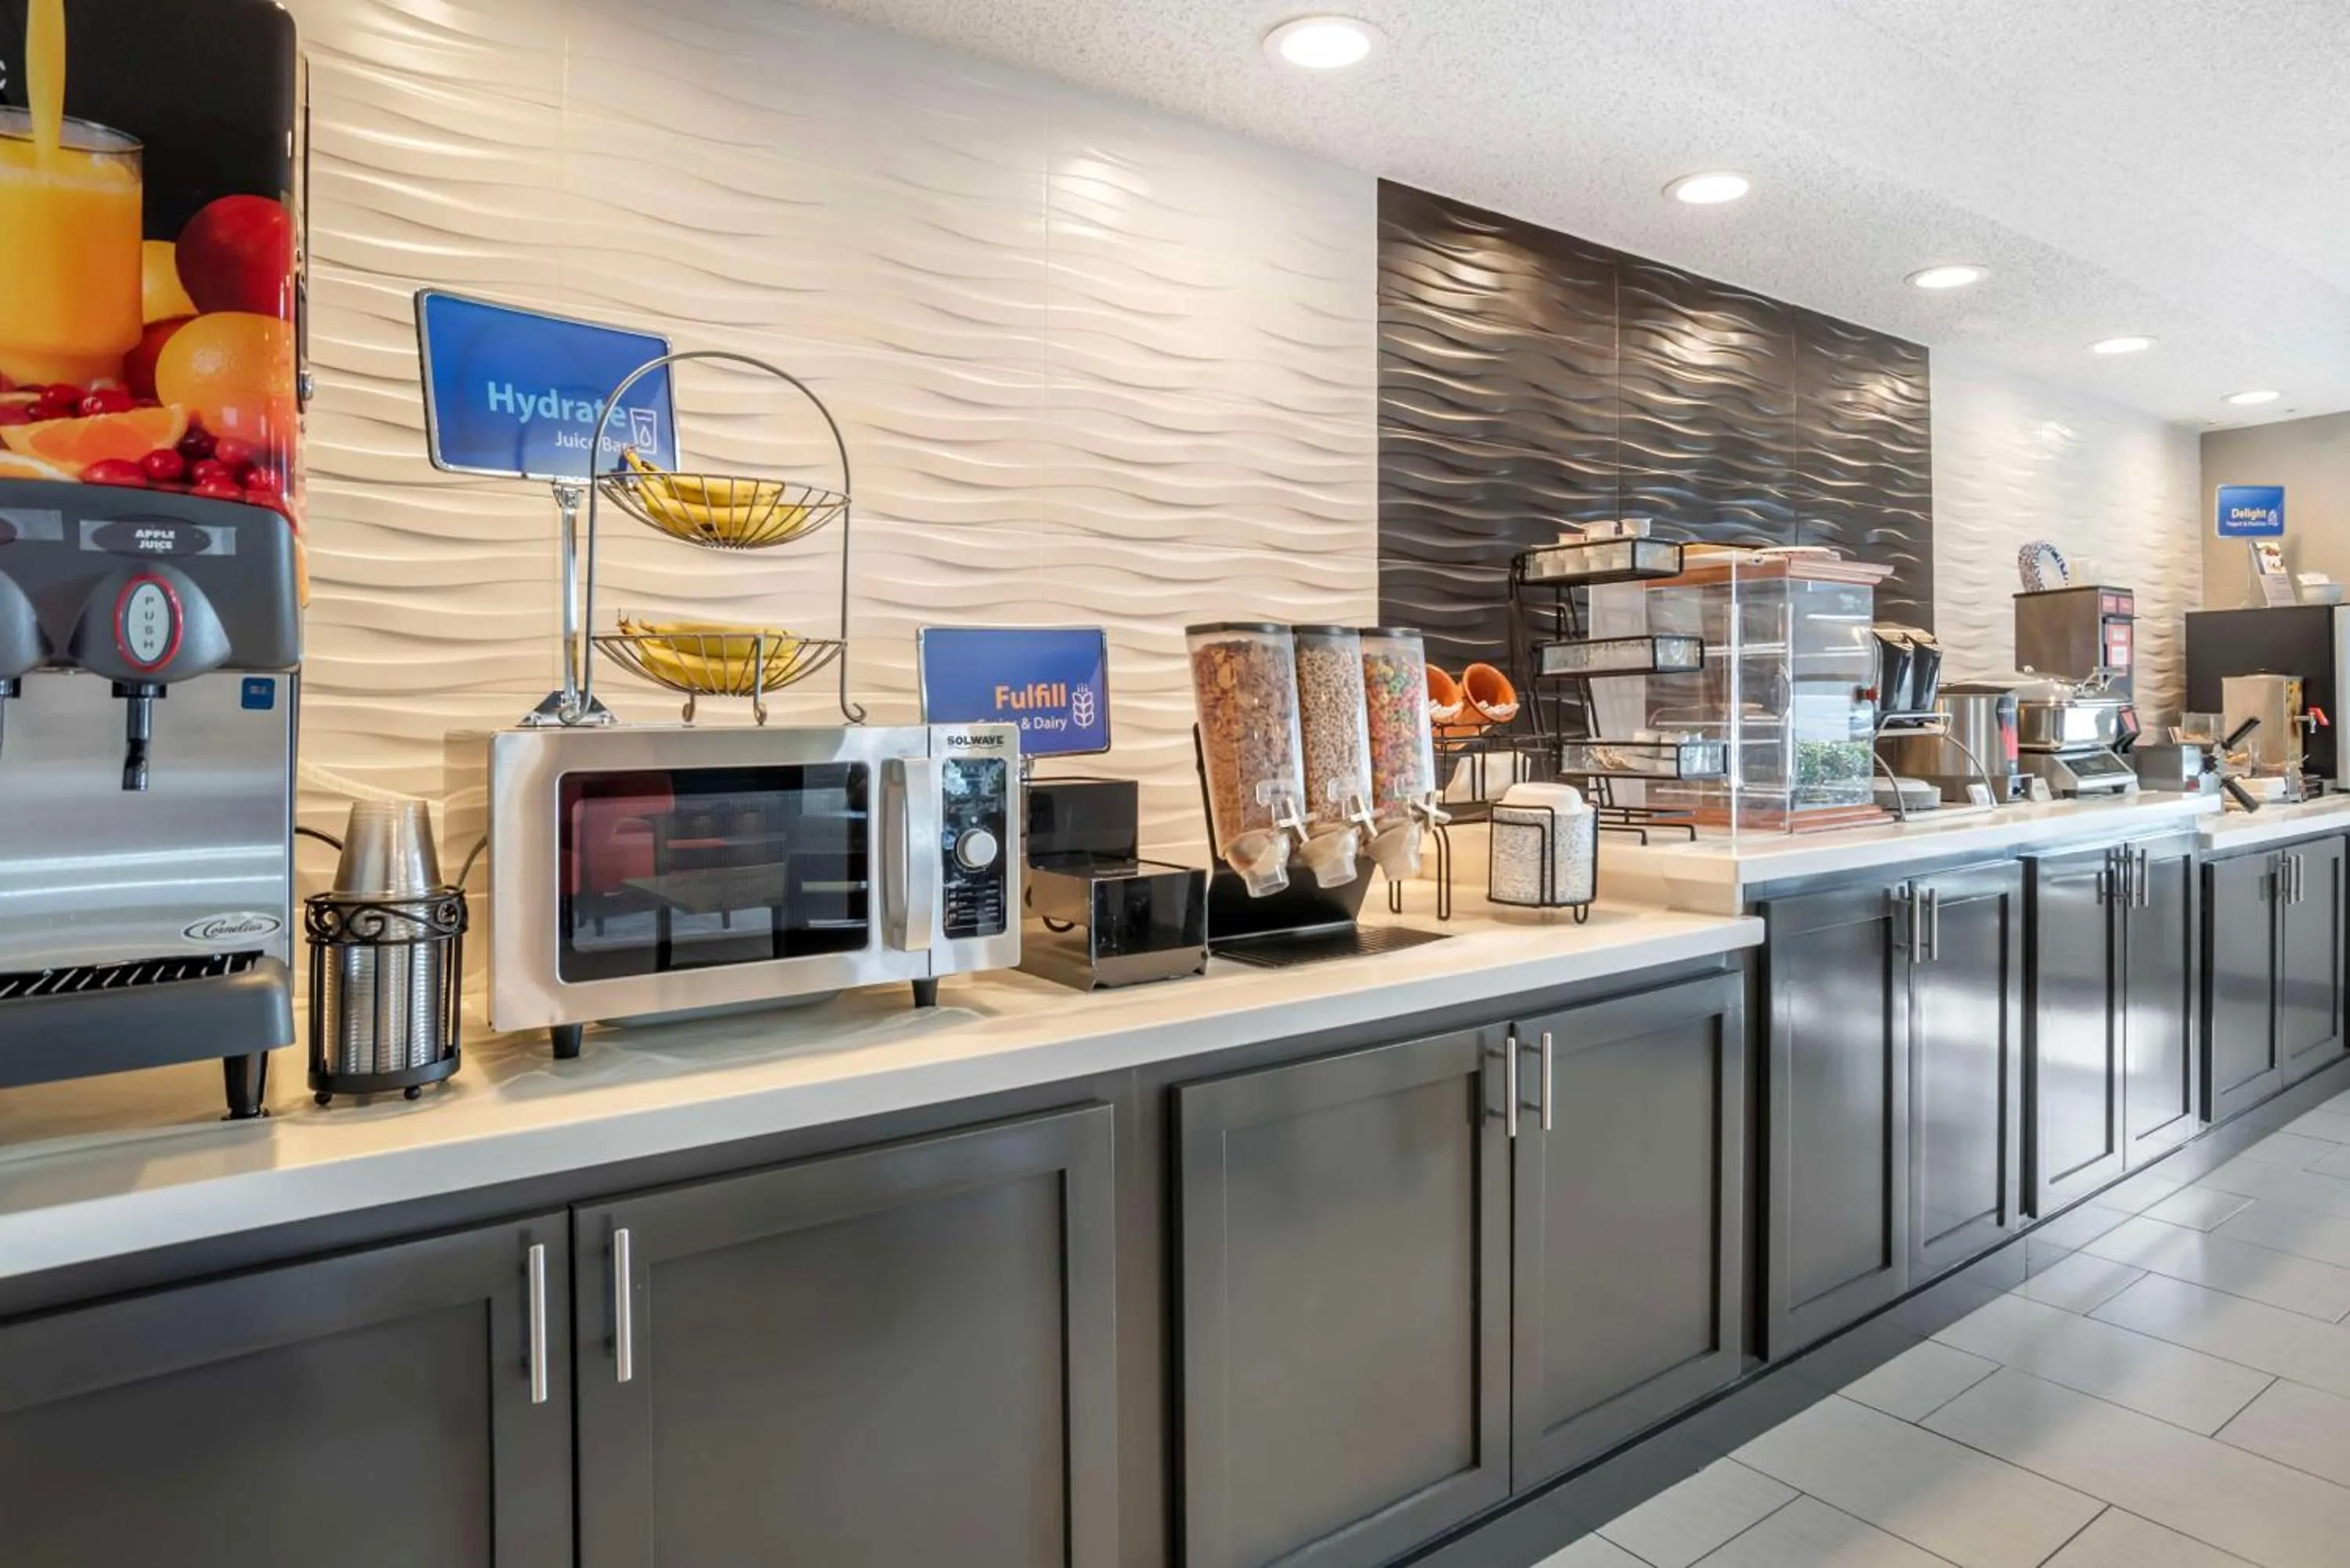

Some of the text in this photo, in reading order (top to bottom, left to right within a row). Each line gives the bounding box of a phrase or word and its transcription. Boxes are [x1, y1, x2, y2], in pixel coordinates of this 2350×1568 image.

[487, 381, 627, 428] Hydrate
[2231, 507, 2266, 521] Delight
[136, 529, 175, 539] APPLE
[138, 540, 173, 549] JUICE
[143, 596, 155, 649] PUSH
[995, 683, 1066, 710] Fulfill
[1021, 716, 1067, 732] & Dairy
[947, 735, 1004, 746] SOLWAVE
